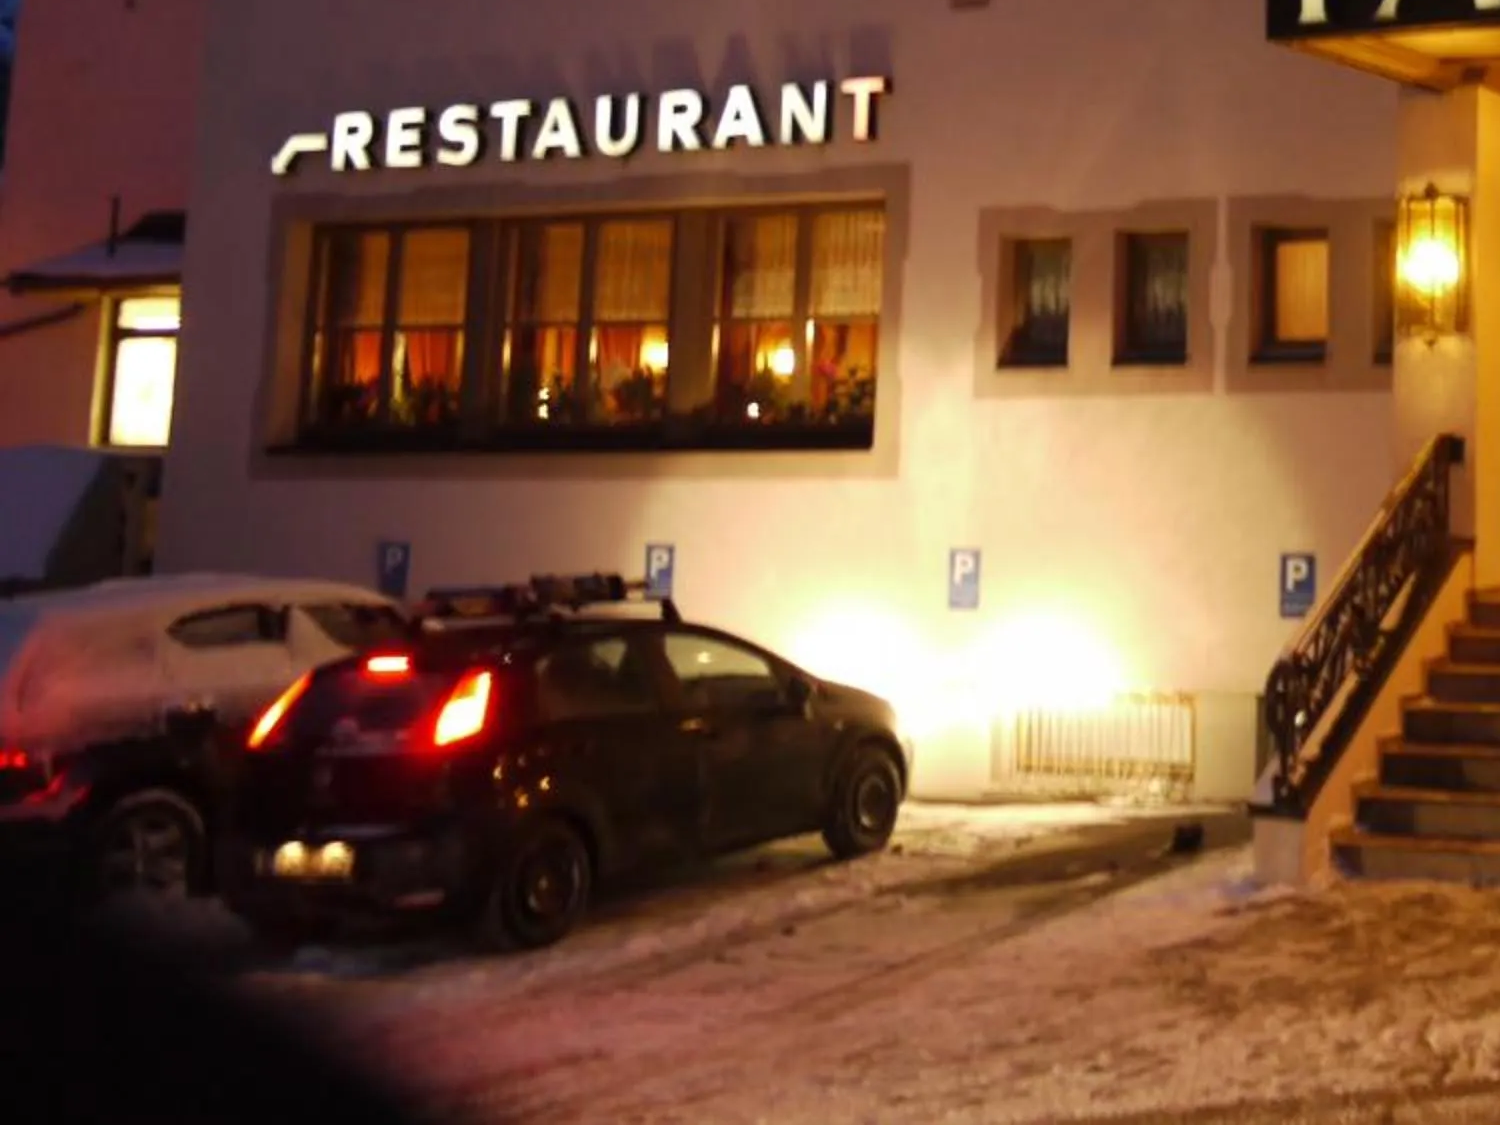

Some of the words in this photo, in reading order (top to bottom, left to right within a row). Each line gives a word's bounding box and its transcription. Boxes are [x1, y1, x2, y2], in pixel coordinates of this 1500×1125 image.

[330, 77, 885, 172] RESTAURANT
[384, 546, 403, 574] P
[649, 547, 670, 580] P
[953, 551, 975, 585] P
[1285, 557, 1308, 592] P
